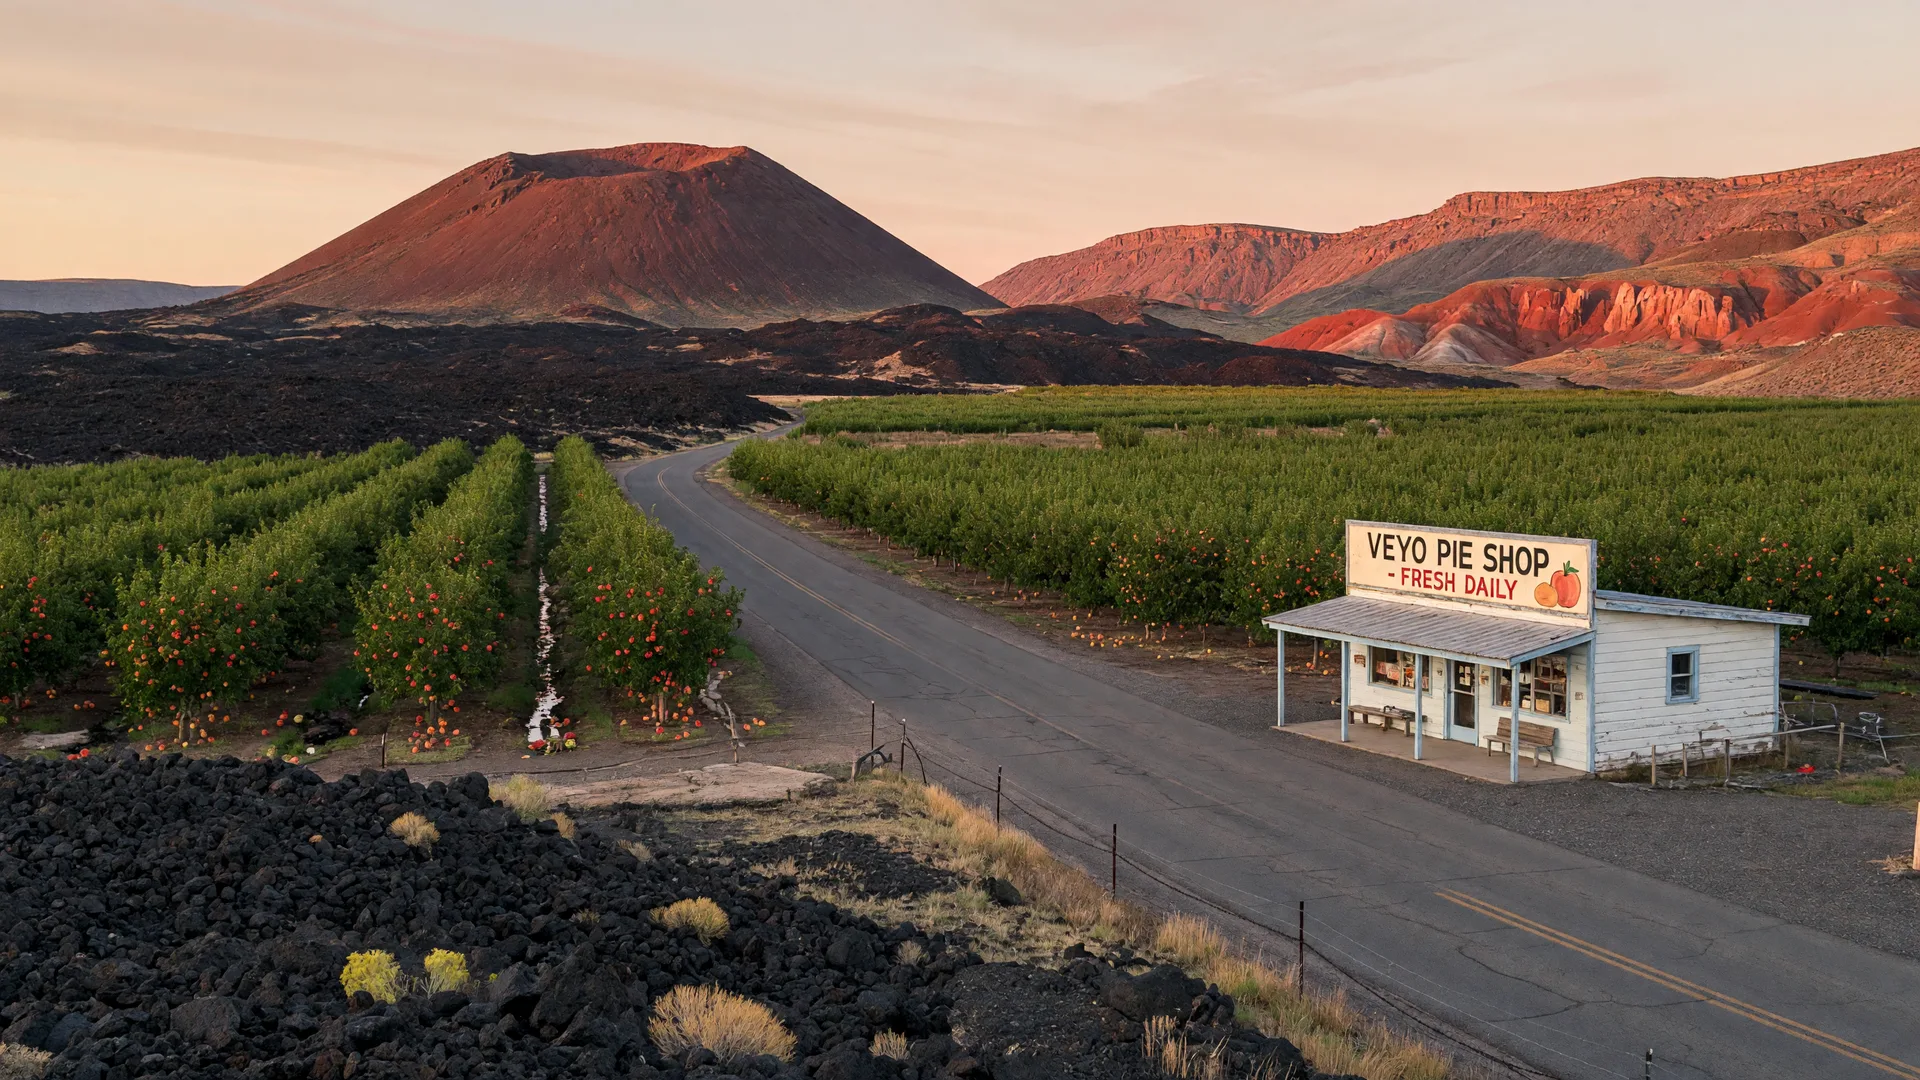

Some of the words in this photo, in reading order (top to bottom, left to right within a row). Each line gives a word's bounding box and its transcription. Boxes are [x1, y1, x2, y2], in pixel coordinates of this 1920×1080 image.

[1367, 532, 1427, 564] VEYO
[1437, 538, 1473, 570] PIE
[1483, 543, 1550, 577] SHOP
[1401, 567, 1456, 593] FRESH
[1464, 574, 1518, 600] DAILY
